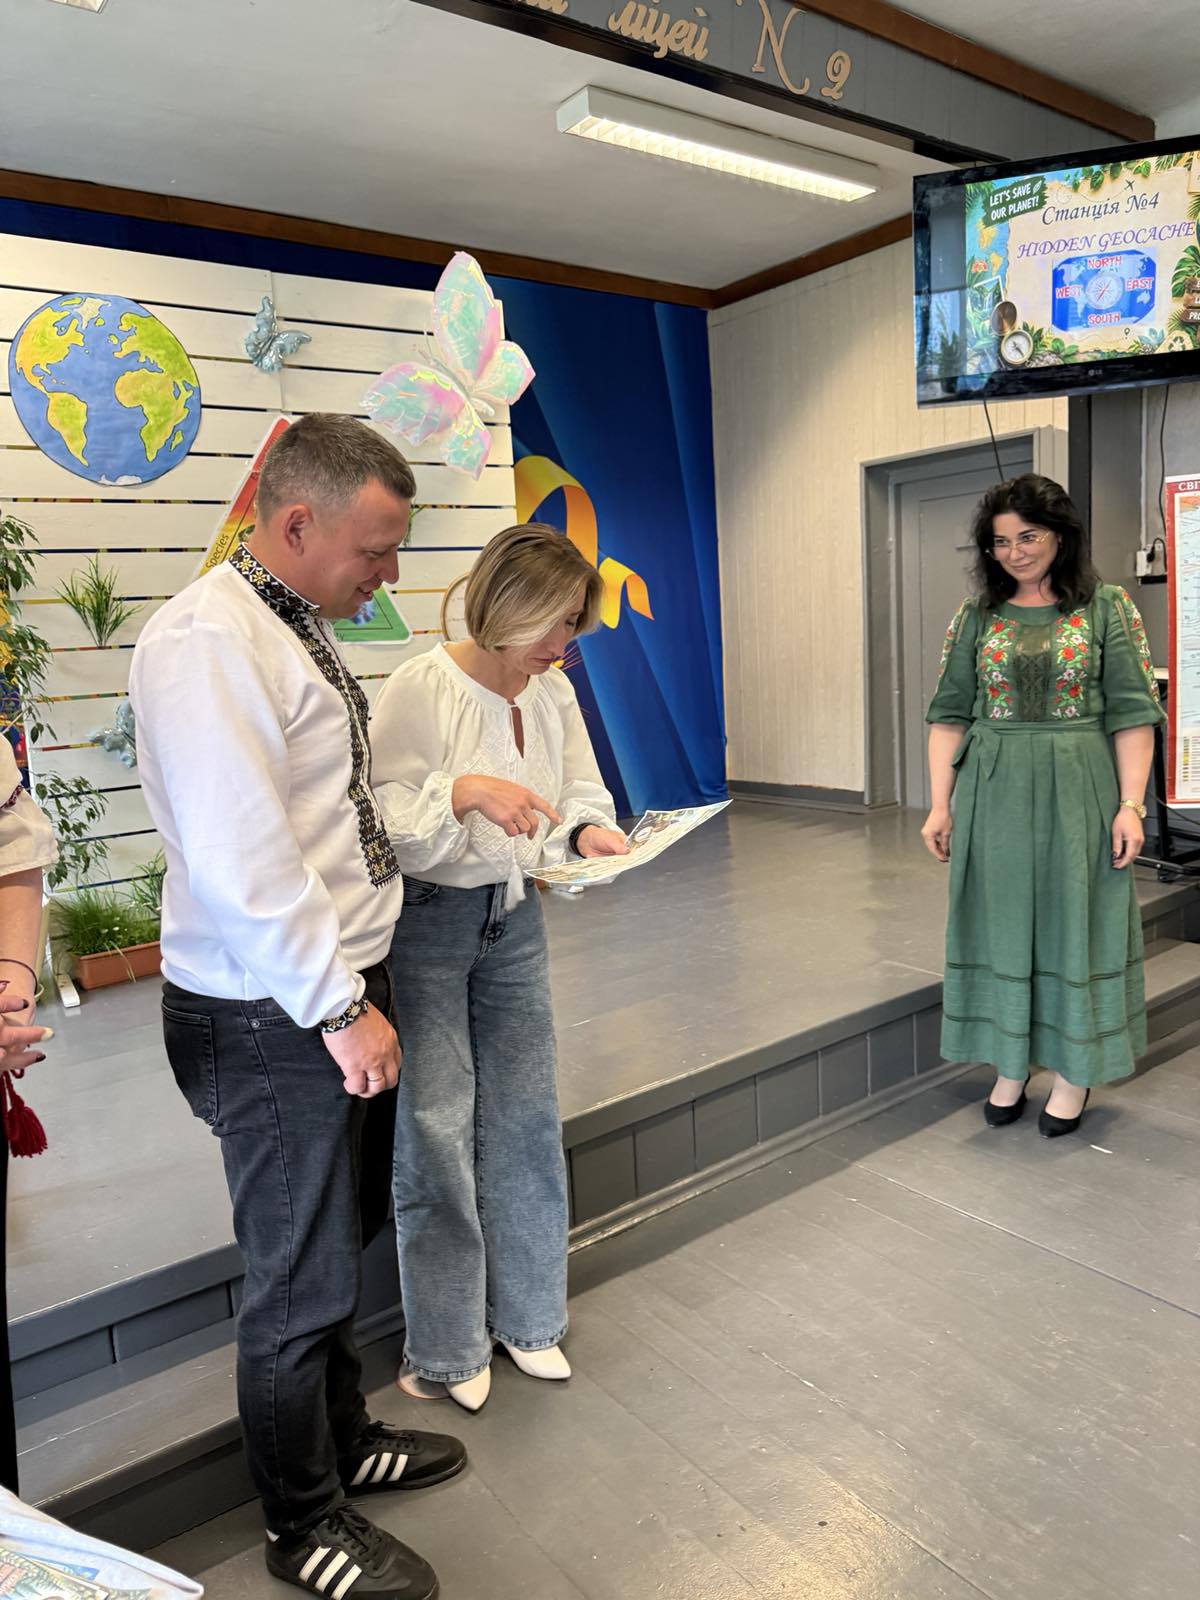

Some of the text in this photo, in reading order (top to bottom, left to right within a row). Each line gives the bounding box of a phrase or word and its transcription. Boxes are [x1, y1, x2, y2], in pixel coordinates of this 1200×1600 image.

[990, 183, 1031, 207] LET'S SAVE
[991, 195, 1040, 221] OUR PLANET!
[1042, 198, 1120, 226] Станція
[1017, 220, 1196, 259] HIDDEN GEOCACHE
[1088, 256, 1122, 268] NORTH
[1056, 277, 1153, 298] WEST EAST
[1088, 312, 1121, 324] SOUTH
[205, 534, 229, 568] Species
